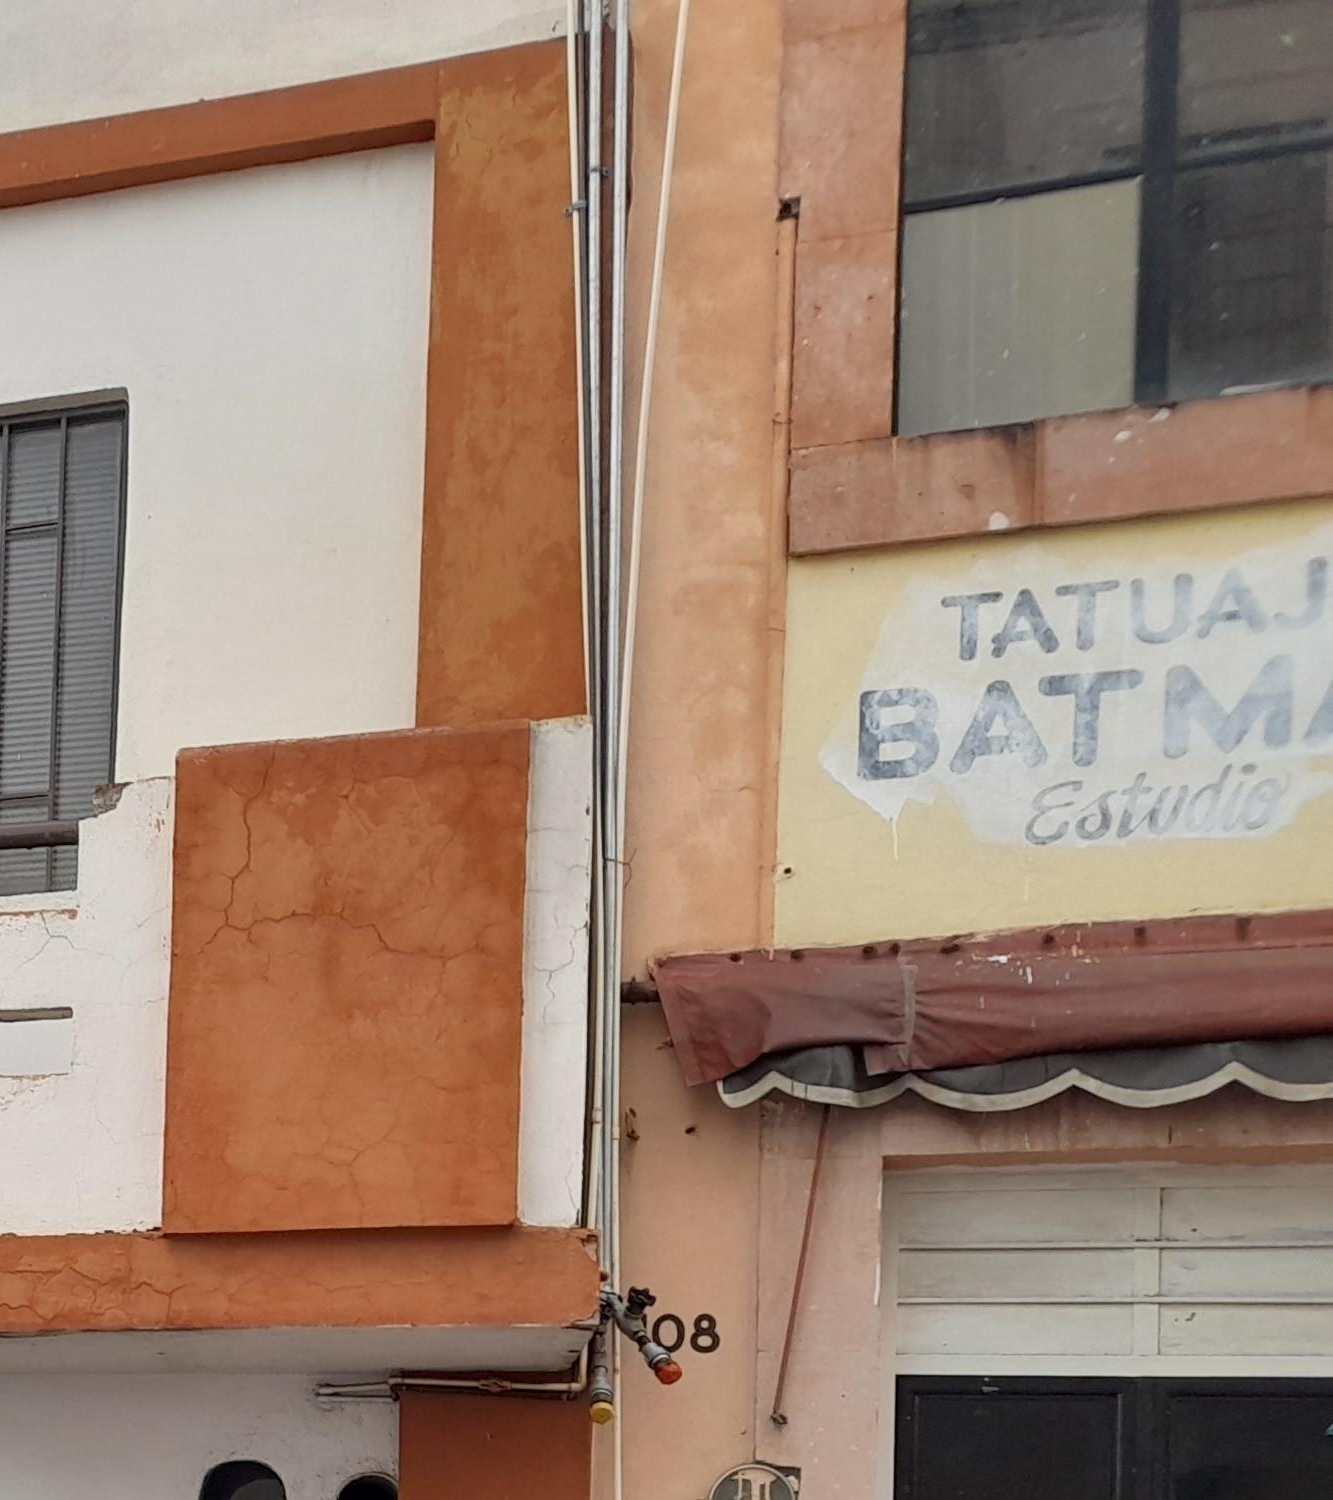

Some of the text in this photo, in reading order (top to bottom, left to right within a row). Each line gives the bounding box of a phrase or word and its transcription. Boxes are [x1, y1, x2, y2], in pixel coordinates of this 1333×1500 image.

[941, 556, 1328, 661] TATUAJ
[1024, 763, 1290, 846] Estudio
[641, 1313, 720, 1353] 08
